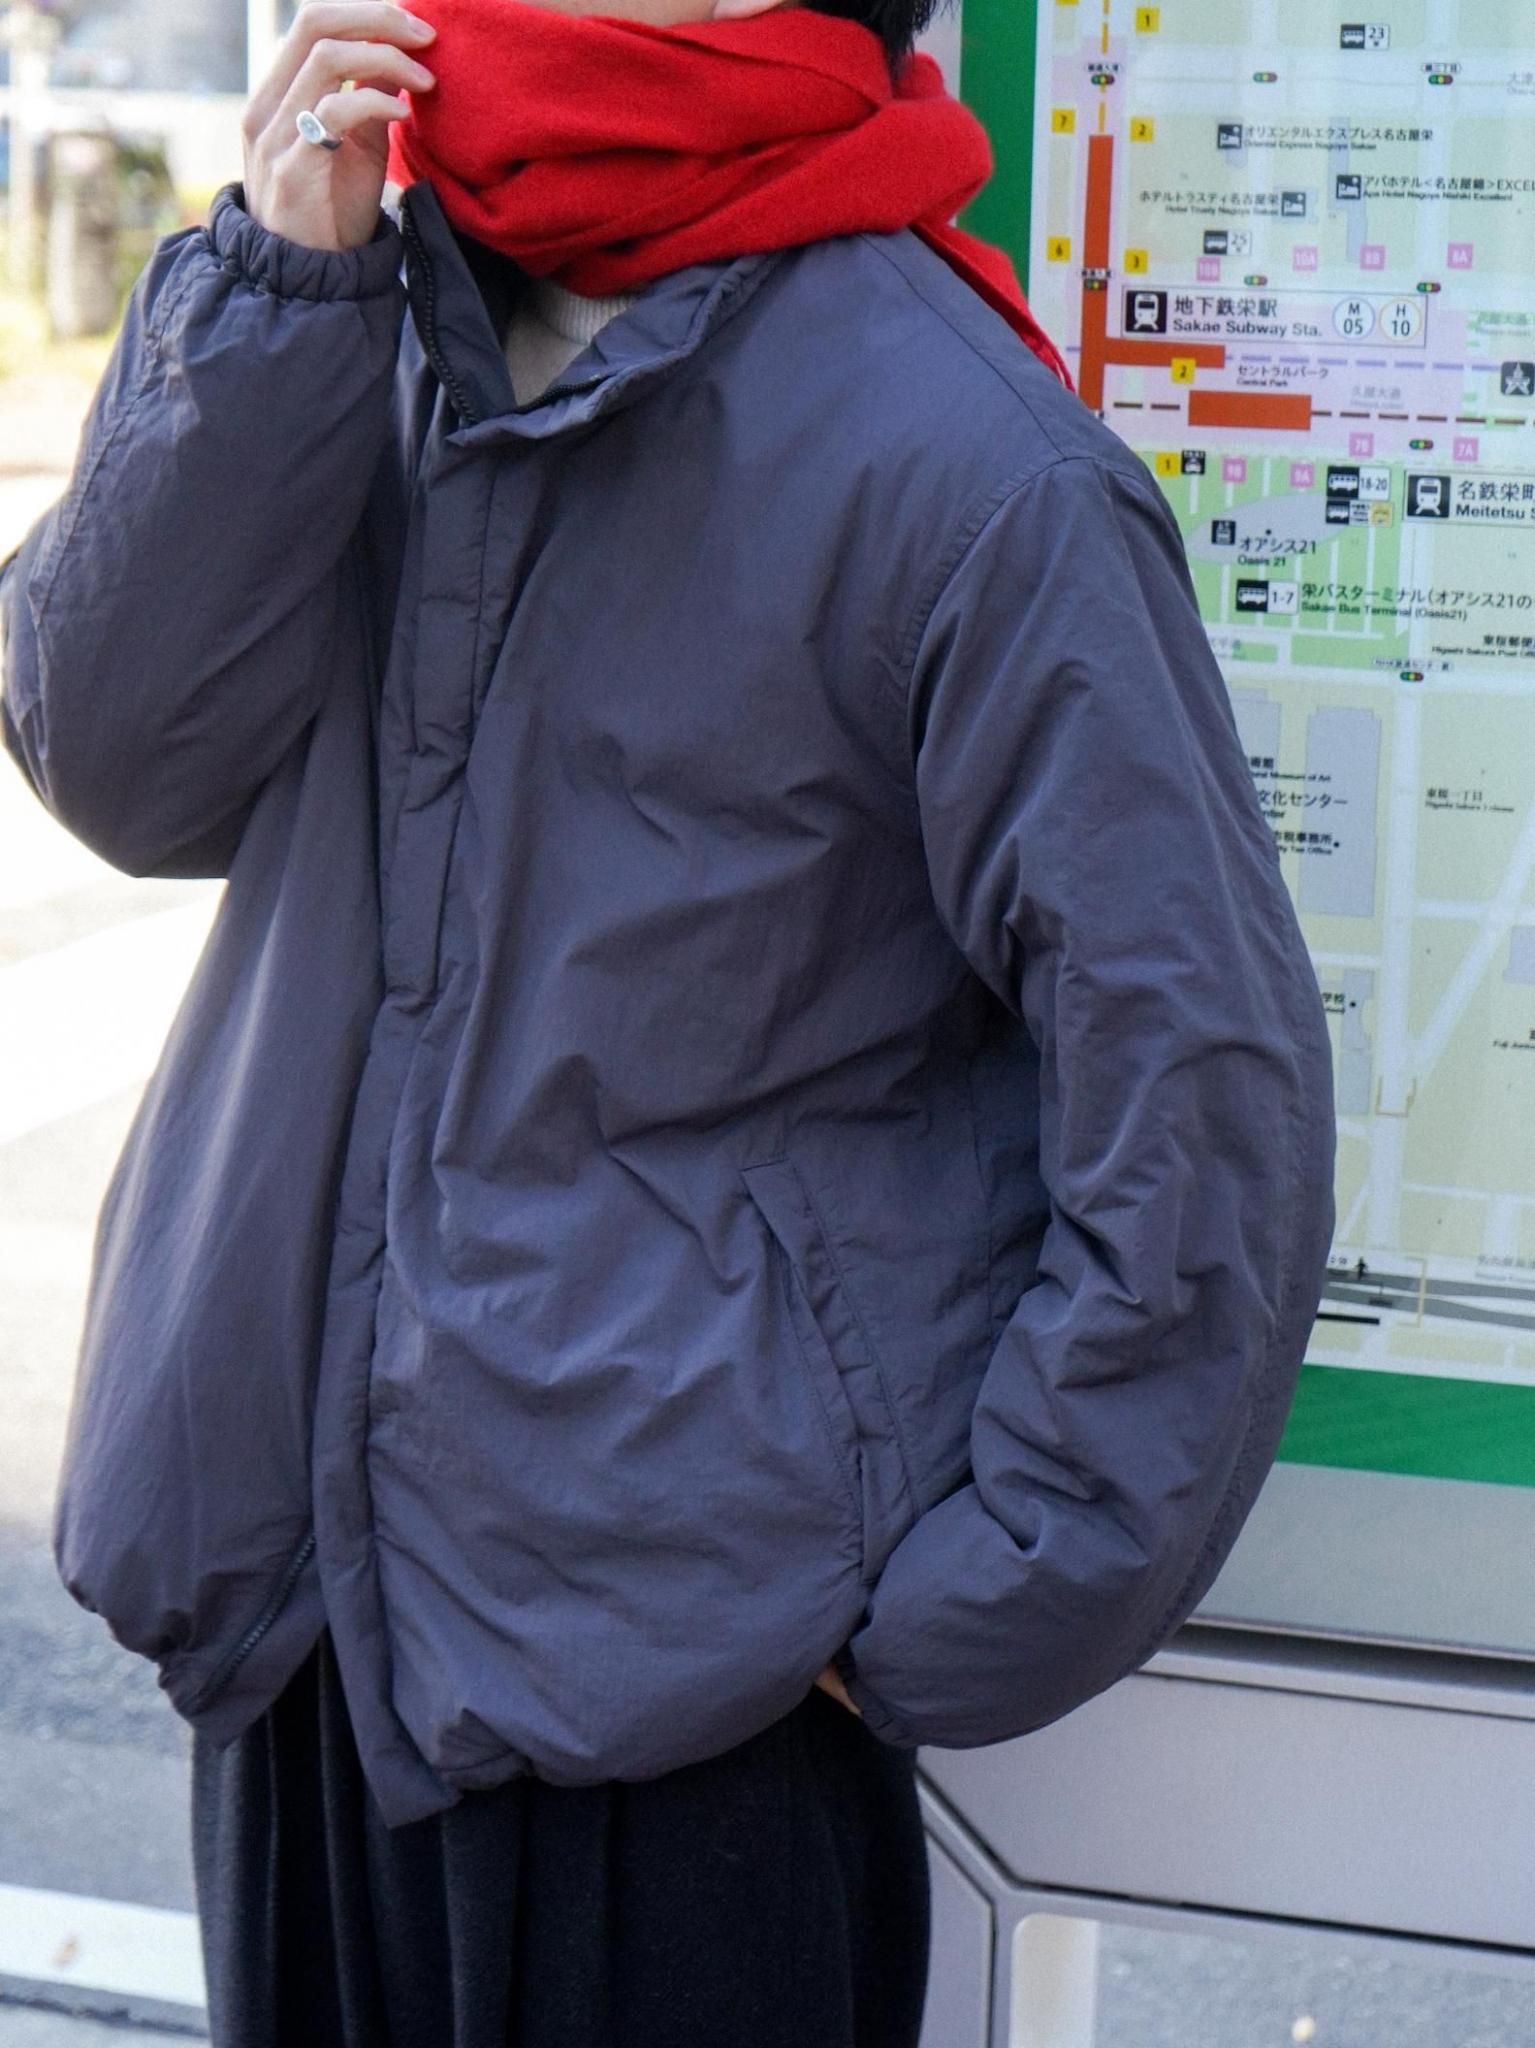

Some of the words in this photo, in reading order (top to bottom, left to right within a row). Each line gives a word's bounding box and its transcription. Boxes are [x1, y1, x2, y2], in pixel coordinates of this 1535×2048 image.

[1369, 27, 1385, 39] 23
[1245, 126, 1434, 141] オリエンタルエクスプレス名古屋栄
[1231, 233, 1247, 245] 25
[1174, 296, 1277, 318] 地下鉄栄駅
[1348, 302, 1360, 315] M
[1396, 304, 1406, 317] H
[1173, 318, 1221, 333] Sakae
[1226, 320, 1287, 338] Subway
[1292, 323, 1323, 337] Sta.
[1343, 319, 1363, 335] 05
[1391, 320, 1411, 336] 10
[1238, 365, 1329, 379] セントラルパーク
[1456, 504, 1525, 519] Meitetsu
[1239, 537, 1316, 555] オアシス21
[1273, 557, 1286, 567] 21
[1271, 591, 1294, 605] 1-7
[1339, 603, 1360, 614] Bus
[1365, 605, 1411, 617] Terminal
[1259, 790, 1348, 808] 文化センター
